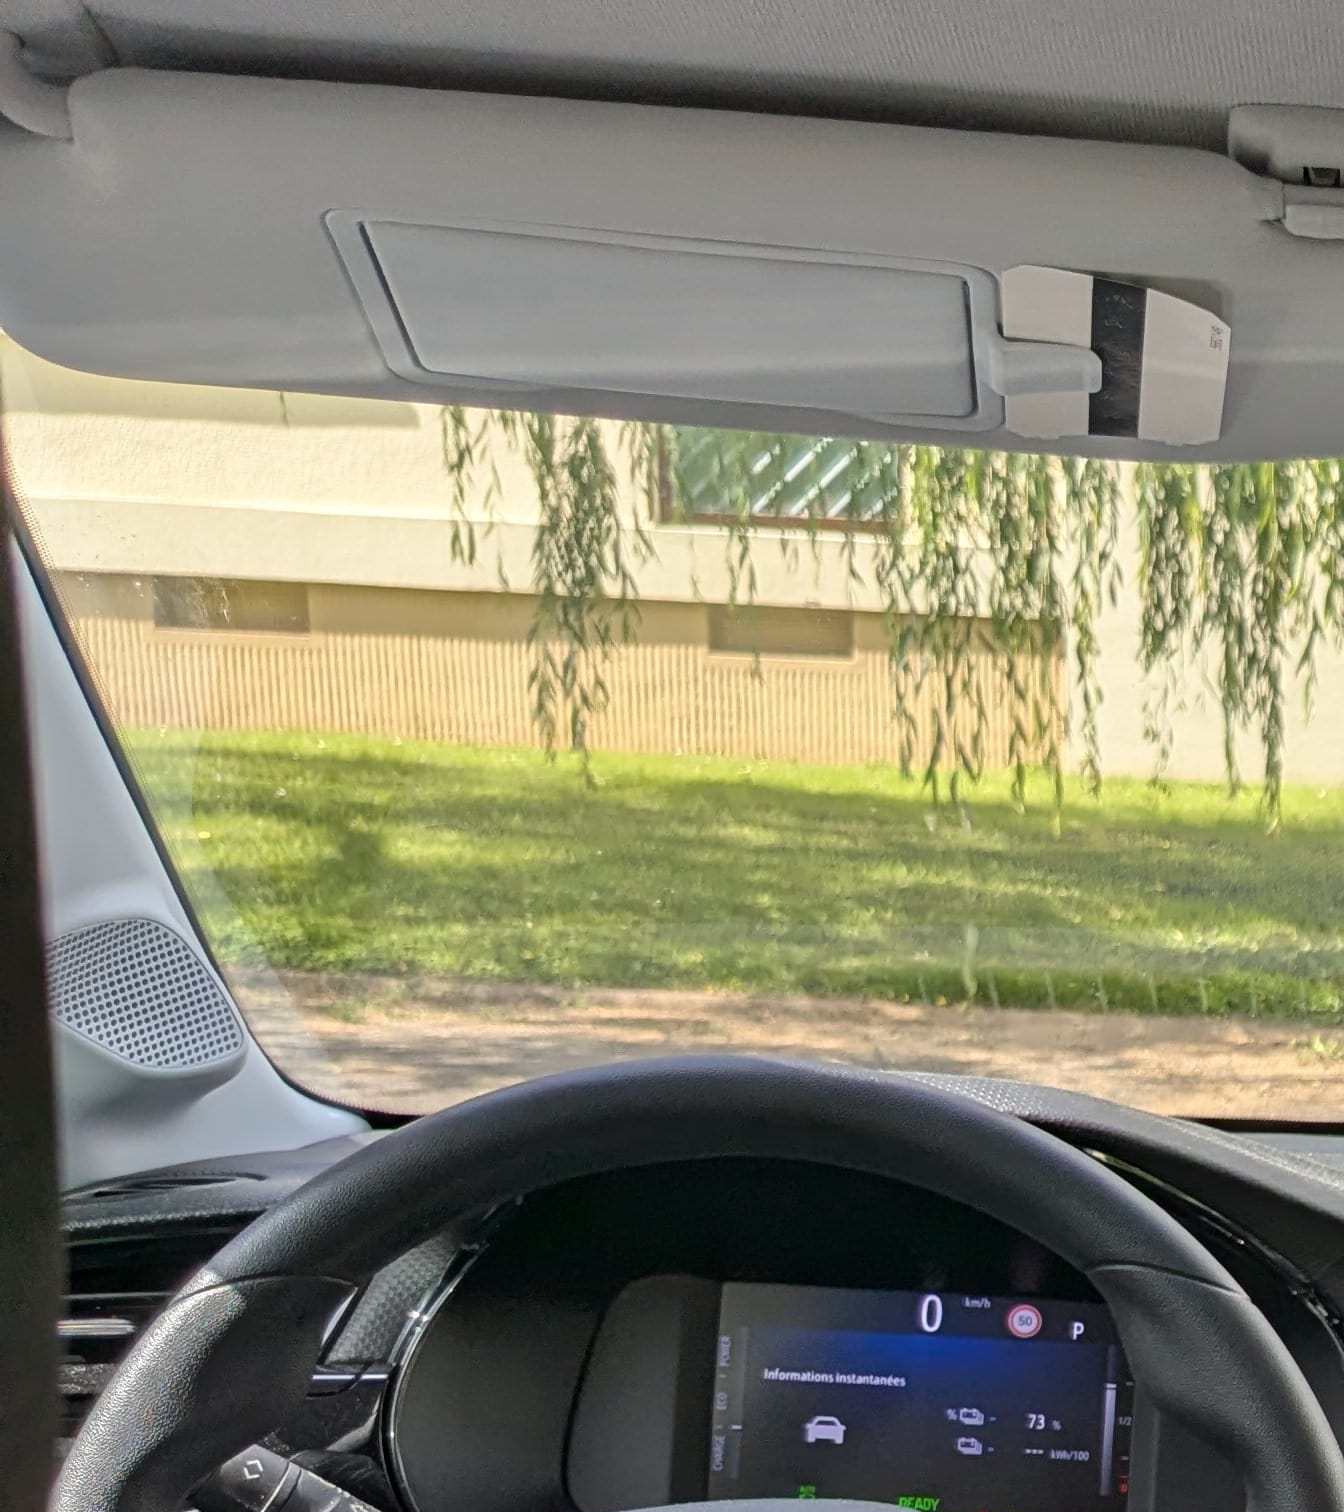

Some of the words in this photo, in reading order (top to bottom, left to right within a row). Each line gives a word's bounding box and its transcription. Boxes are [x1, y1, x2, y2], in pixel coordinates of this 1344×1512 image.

[965, 1297, 991, 1309] km/h
[921, 1294, 943, 1333] 0
[1018, 1315, 1033, 1327] 50
[1071, 1321, 1085, 1341] P
[763, 1367, 834, 1383] Informations
[835, 1371, 907, 1387] instantanées
[1028, 1413, 1046, 1430] 73
